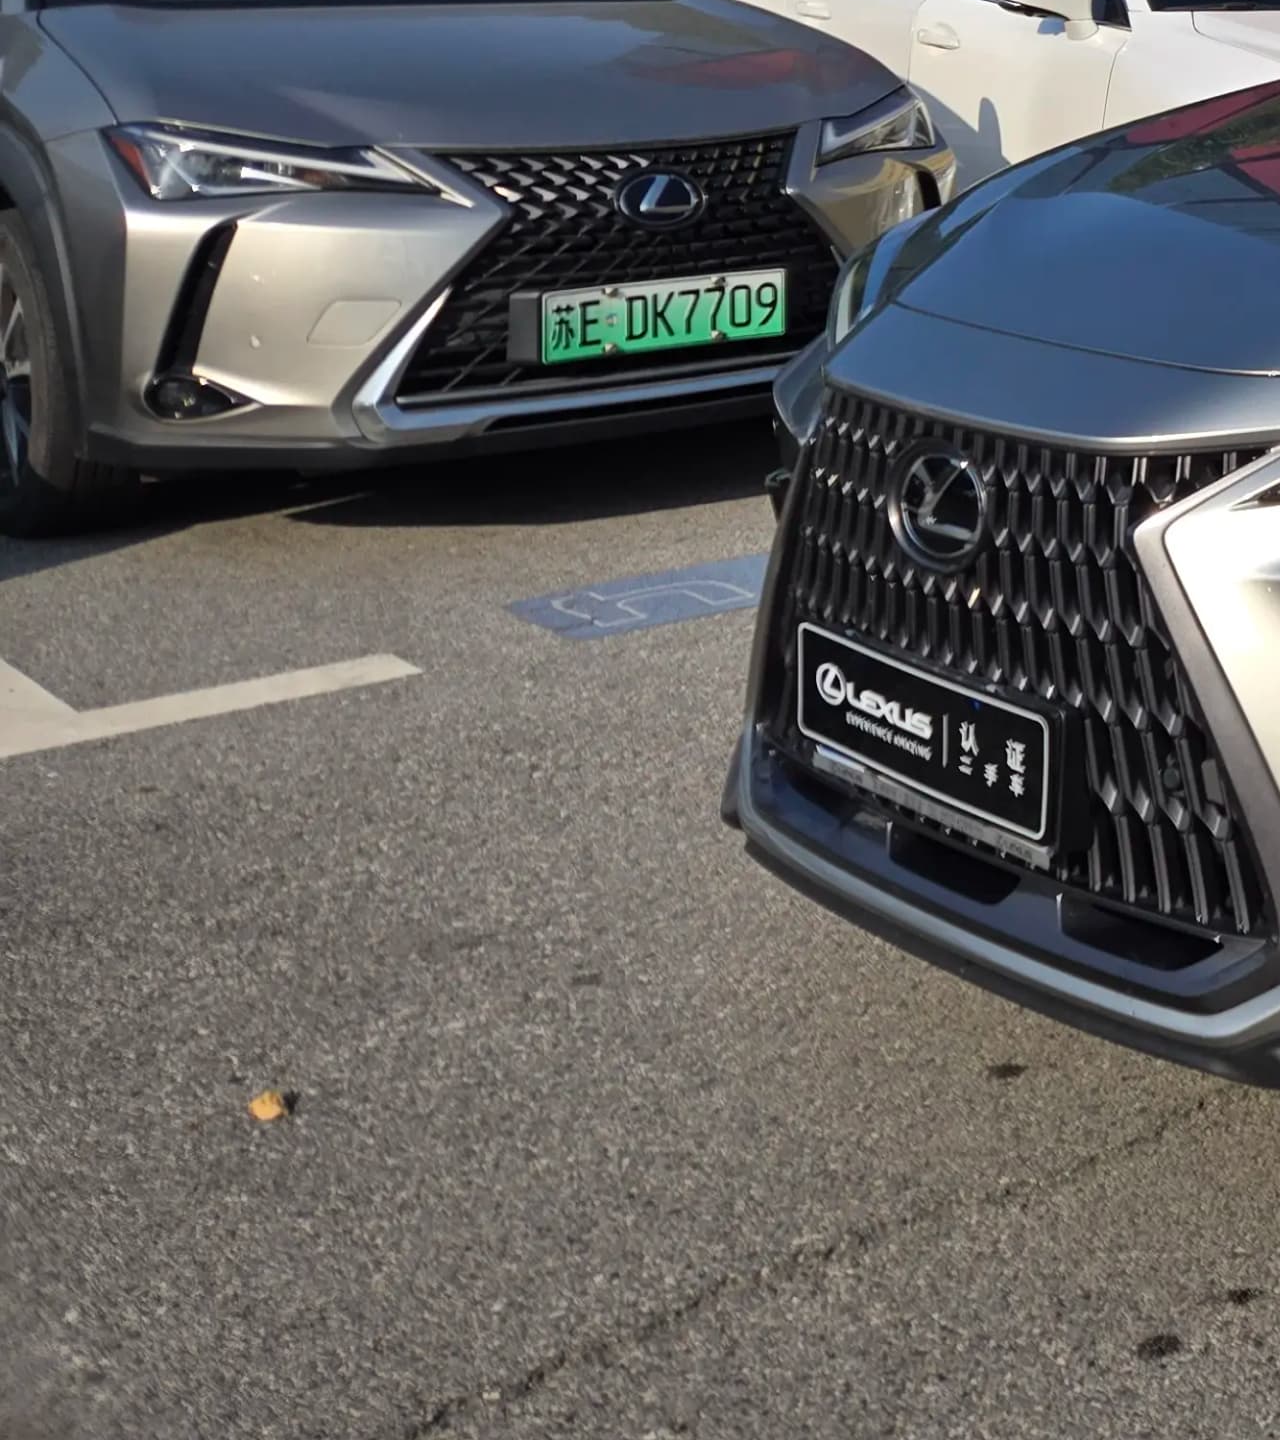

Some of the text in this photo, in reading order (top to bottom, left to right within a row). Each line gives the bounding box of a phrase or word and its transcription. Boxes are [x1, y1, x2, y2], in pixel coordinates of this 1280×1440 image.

[846, 681, 933, 740] LEXUS
[958, 720, 1027, 774] 认证
[957, 754, 1026, 798] 二手车
